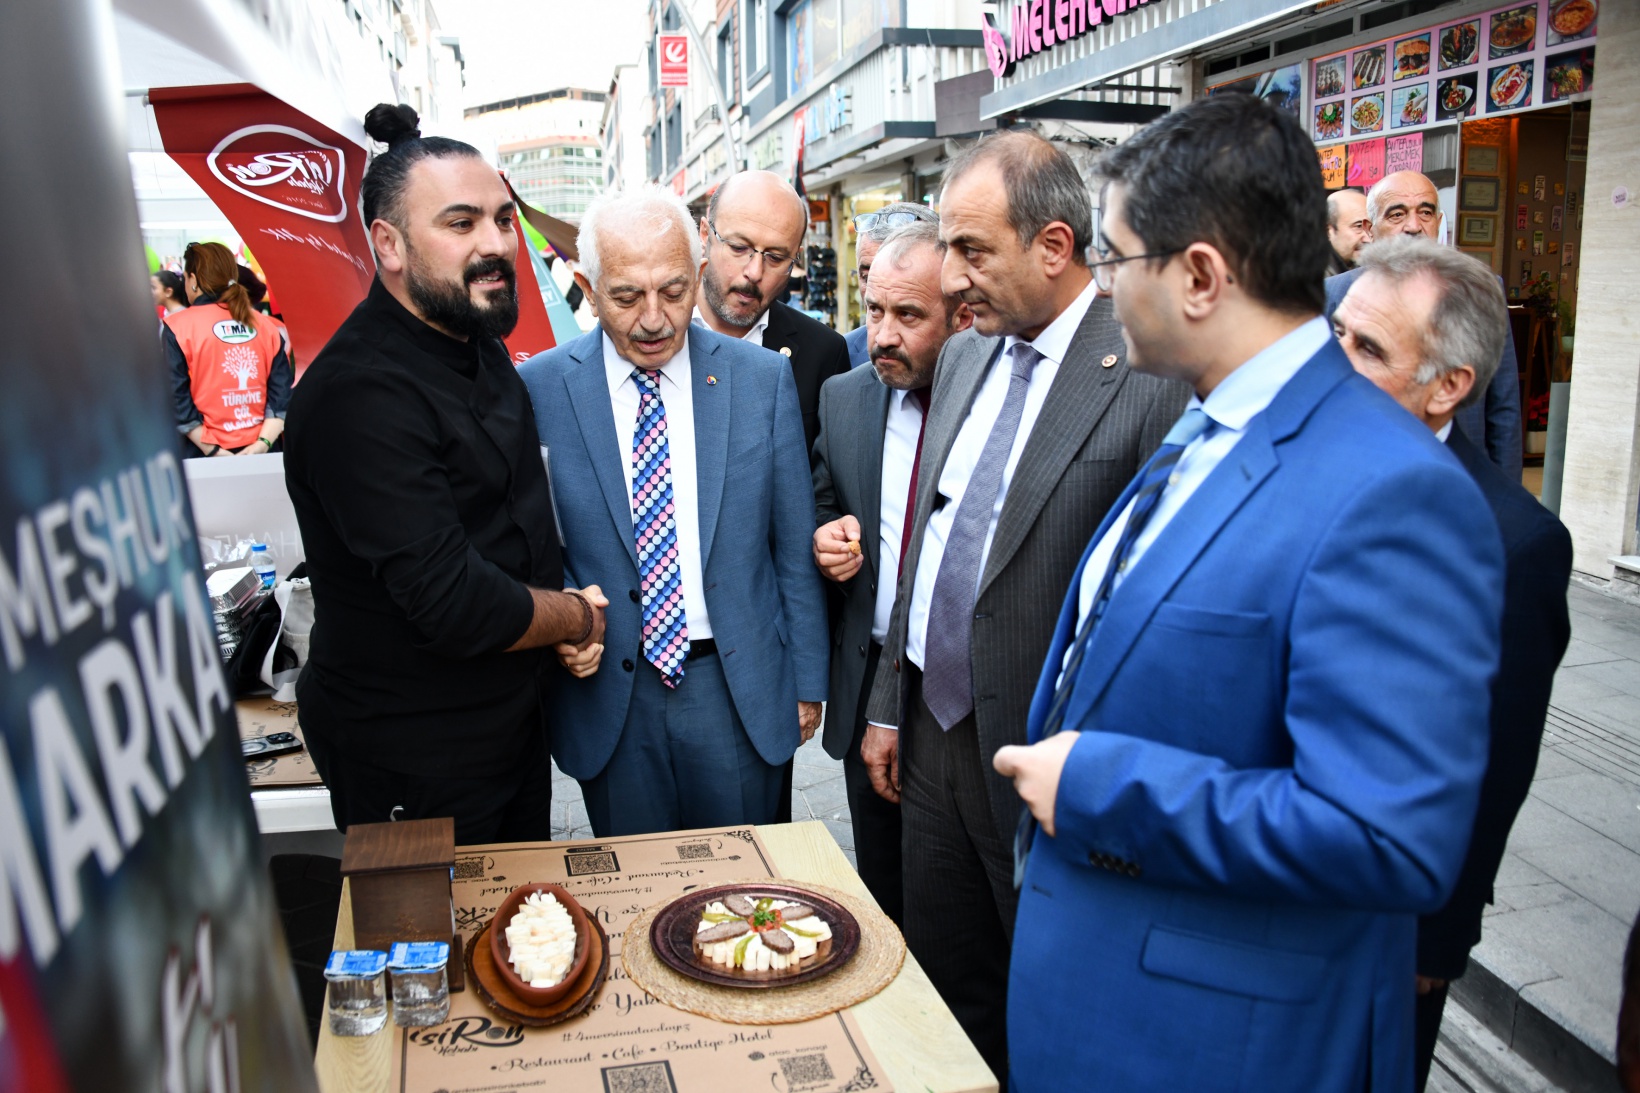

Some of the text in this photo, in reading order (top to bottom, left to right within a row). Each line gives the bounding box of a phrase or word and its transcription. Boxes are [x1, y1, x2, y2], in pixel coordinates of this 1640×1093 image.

[221, 324, 247, 334] TEMA
[222, 391, 261, 407] TÜRKİYE
[234, 405, 252, 420] ÇÖL
[0, 450, 191, 672] MEŞHUR
[498, 1052, 594, 1073] Restaurant
[612, 1044, 644, 1060] Cafe
[728, 1029, 774, 1045] Hotel
